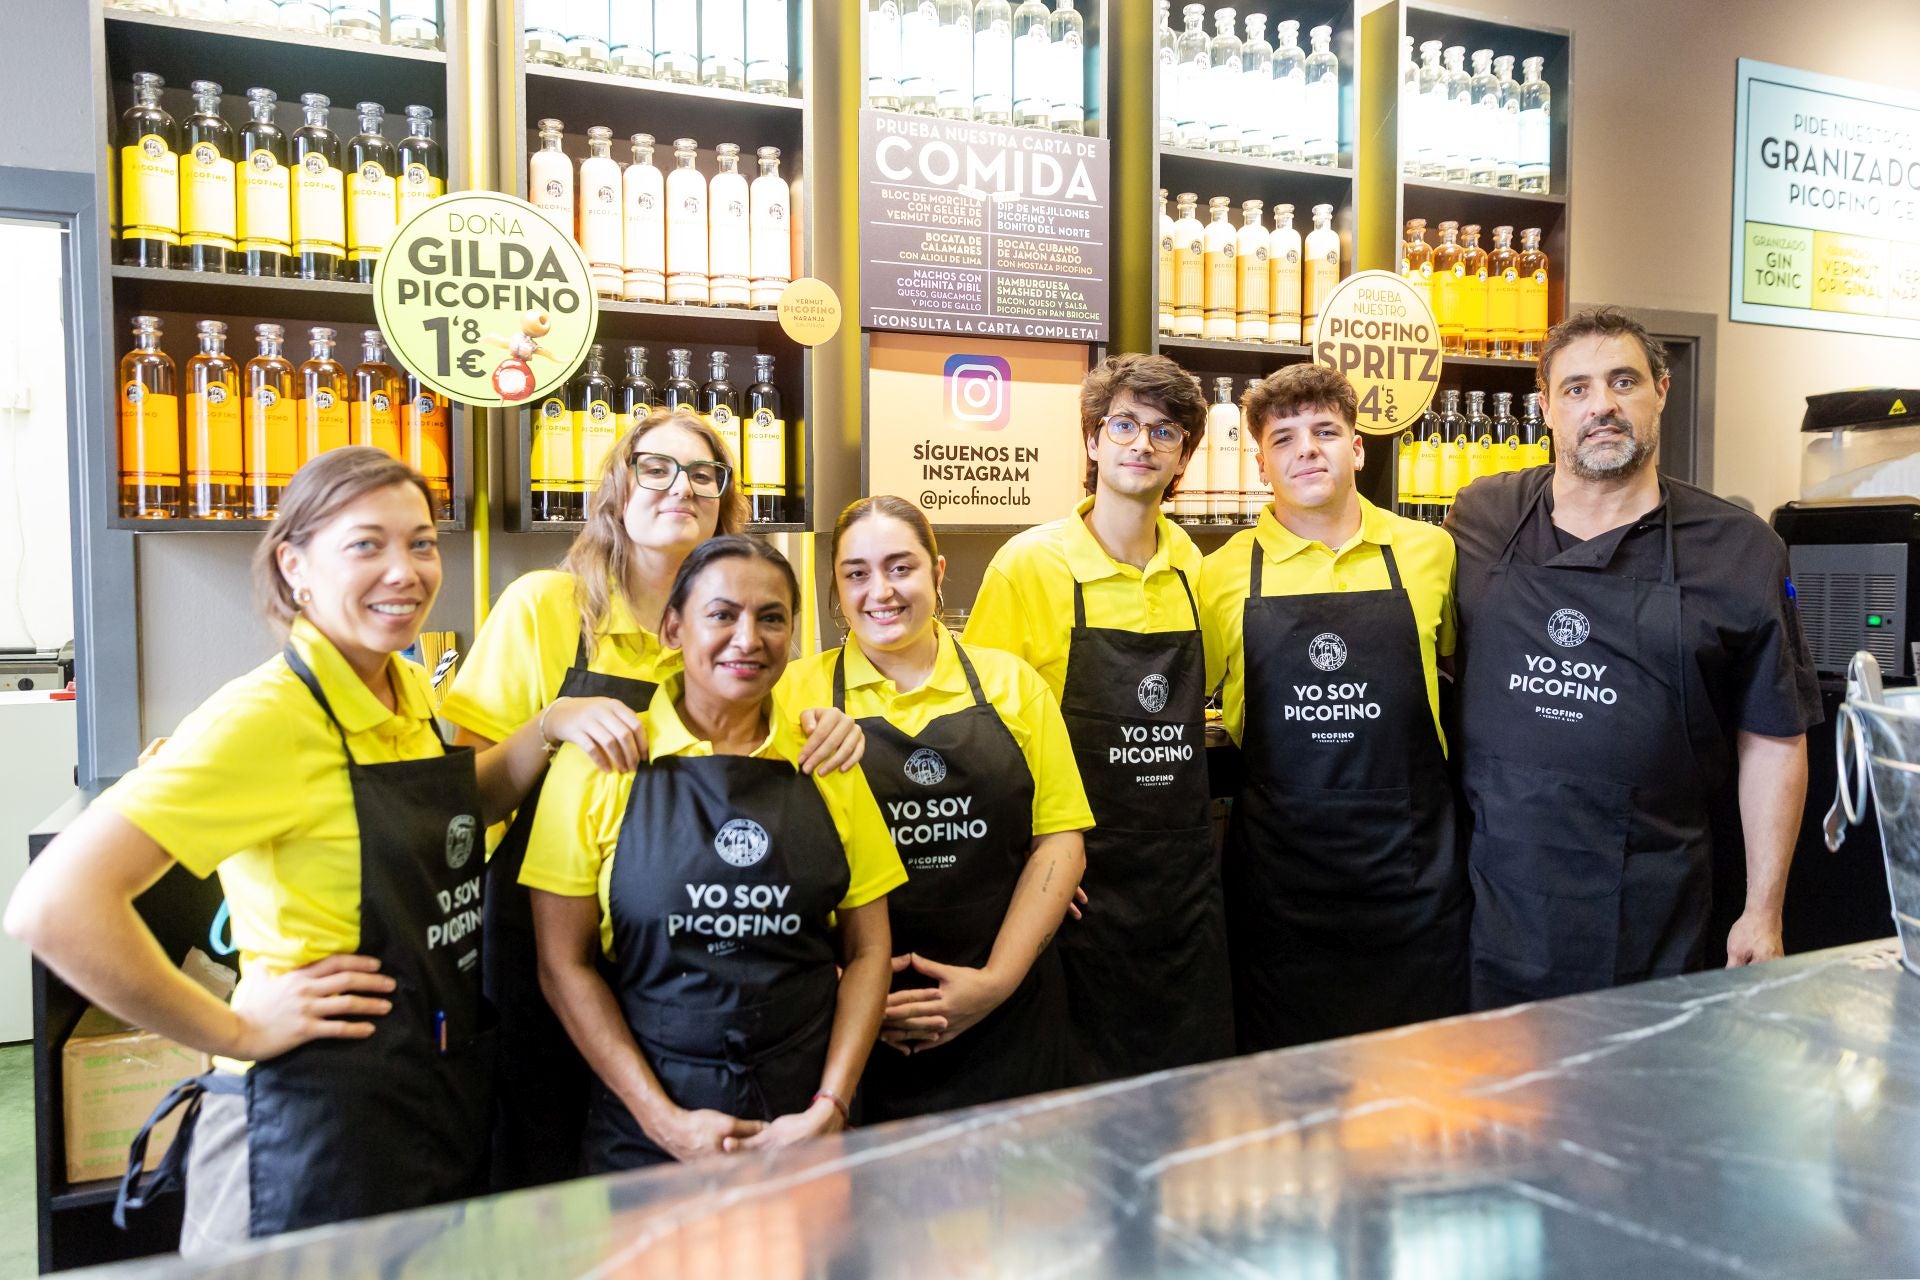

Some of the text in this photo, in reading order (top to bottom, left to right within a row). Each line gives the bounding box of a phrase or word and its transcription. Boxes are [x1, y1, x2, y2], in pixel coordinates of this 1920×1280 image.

[1794, 113, 1828, 136] PIDE
[876, 118, 1096, 158] PRUEBA NUESTRA CARTA DE
[875, 135, 1097, 202] COMIDA
[881, 189, 982, 208] BLOC DE MORCILLA
[1790, 183, 1881, 216] PICOFINO
[887, 210, 982, 227] VERMUT PICOFINO
[908, 202, 931, 212] CON
[970, 207, 982, 218] DE
[997, 201, 1090, 219] DIP DE MEJILLONES
[997, 211, 1055, 225] PICOFINO Y
[449, 211, 524, 238] DOÑA
[997, 221, 1090, 238] BONITO DEL NORTE
[926, 232, 982, 246] BOCATA DE
[997, 239, 1079, 254] BOCATA CUBANO
[921, 241, 982, 256] CALAMARES
[997, 247, 1082, 264] DE JAMÓN ASADO
[408, 237, 569, 283] GILDA
[899, 251, 982, 265] CON ALIOLI DE LIMA
[1767, 252, 1791, 269] GIN
[913, 269, 982, 283] NACHOS CON
[997, 260, 1093, 275] CON MOSTAZA PICOFINO
[897, 278, 981, 292] COCHINITA PIBIL
[997, 277, 1070, 291] HAMBURGUESA
[1756, 269, 1801, 290] TONIC
[398, 279, 579, 314] PICOFINO
[897, 288, 982, 301] QUESO, GUACAMOLE
[997, 286, 1084, 301] SMASHED DE VACA
[1358, 288, 1402, 303] PRUEBA
[783, 305, 835, 315] PICOFINO
[912, 299, 982, 311] Y PICO DE GALLO
[997, 297, 1088, 310] BACON, QUESO Y SALSA
[1353, 302, 1406, 317] NUESTRO
[997, 305, 1100, 320] PICOFINO EN PAN BRIOCHE
[873, 315, 1098, 340] ¡CONSULTA LA CARTA COMPLETA!
[1331, 318, 1429, 343] PICOFINO
[1318, 341, 1439, 382] SPRITZ
[913, 440, 1039, 462] SÍGUENOS EN
[923, 465, 1030, 482] INSTAGRAM
[920, 486, 1031, 510] @picofinoclub
[1525, 654, 1607, 681] YO SOY
[1293, 683, 1368, 701] YO SOY
[1509, 674, 1617, 705] PICOFINO
[1284, 703, 1381, 721] PICOFINO
[1535, 706, 1583, 719] PICOFINO
[1120, 725, 1184, 742] YO SOY
[1109, 745, 1193, 763] PICOFINO
[887, 796, 972, 821] YO SOY
[890, 819, 987, 845] ICOFINO
[908, 855, 956, 865] PICOFINO
[685, 883, 791, 909] YO SOY
[668, 914, 801, 938] PICOFINO
